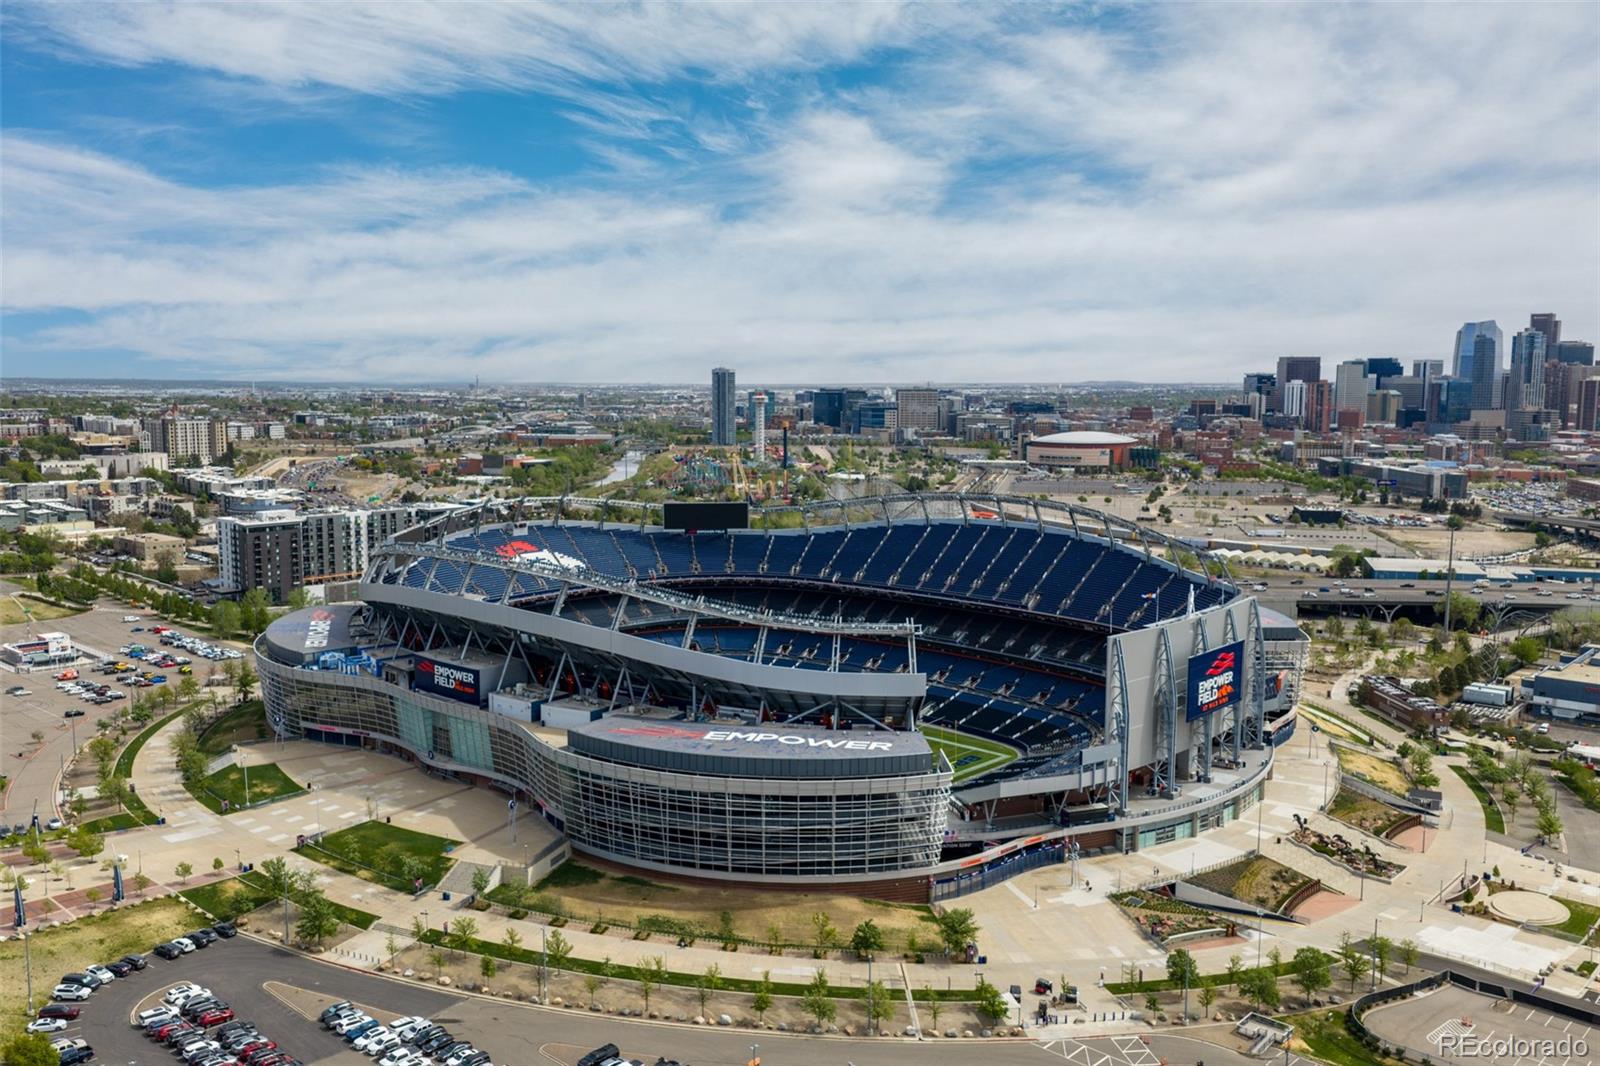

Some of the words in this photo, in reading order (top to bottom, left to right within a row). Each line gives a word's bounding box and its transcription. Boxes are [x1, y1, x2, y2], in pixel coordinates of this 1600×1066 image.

[434, 664, 475, 684] EMPOWER
[434, 675, 456, 689] FIELD
[1198, 671, 1234, 694] EMPOWER
[1197, 688, 1218, 706] FIELD
[703, 731, 893, 751] EMPOWER
